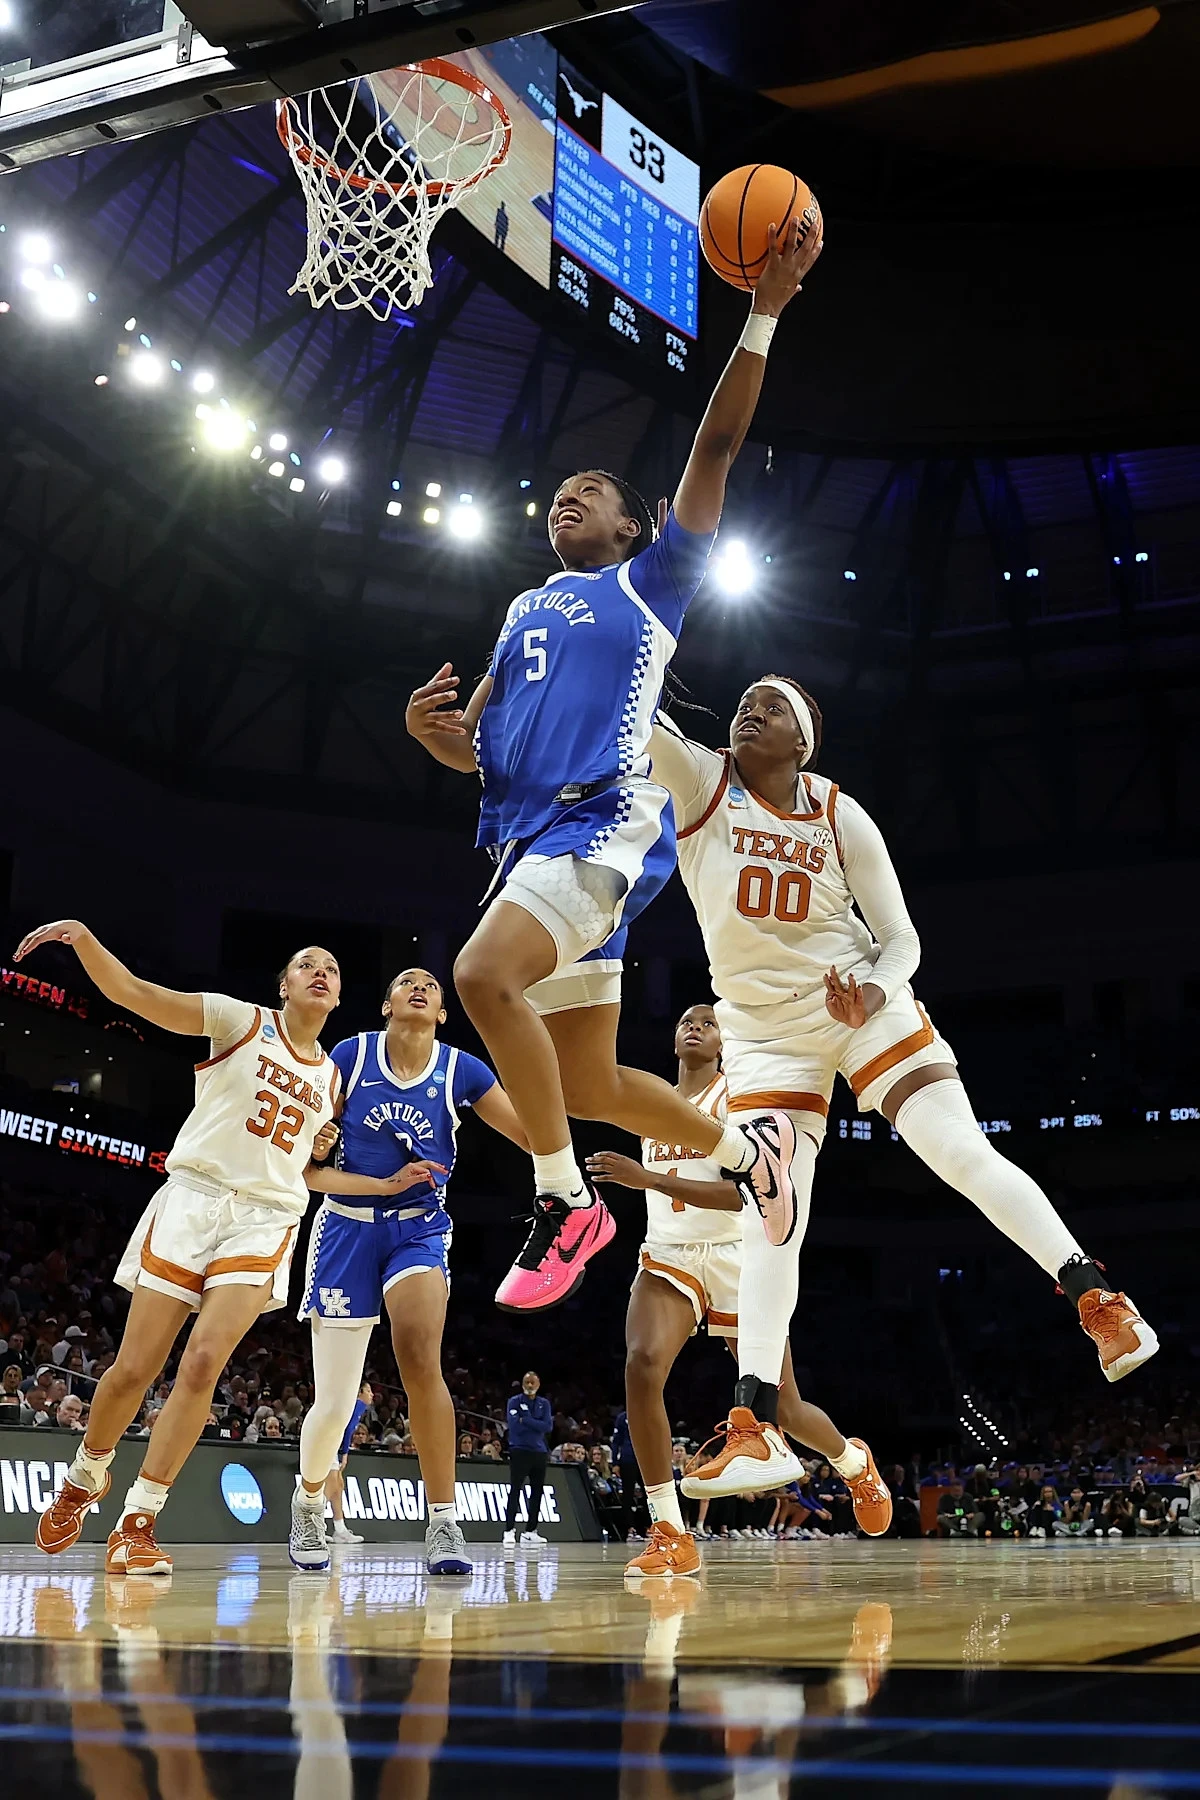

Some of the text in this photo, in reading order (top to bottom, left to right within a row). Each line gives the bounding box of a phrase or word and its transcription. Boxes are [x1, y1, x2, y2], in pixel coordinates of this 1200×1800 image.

[556, 127, 590, 166] PLAYER
[620, 180, 638, 203] PTS
[629, 127, 665, 184] 33
[560, 255, 588, 288] 3PT%
[666, 332, 687, 356] FT%
[498, 591, 596, 643] KENTUCKY
[523, 627, 548, 682] 5
[732, 826, 828, 874] TEXAS
[815, 829, 833, 847] SEC
[736, 864, 812, 923] 00
[256, 1054, 323, 1113] TEXAS
[245, 1090, 305, 1155] 32
[363, 1102, 434, 1141] KENTUCKY
[978, 1120, 1012, 1133] 1.3%
[1073, 1114, 1102, 1127] 25%
[1146, 1110, 1160, 1122] FT
[1170, 1108, 1200, 1121] 50%
[59, 1125, 146, 1167] SIXTEEN
[319, 1287, 351, 1316] UK
[227, 1492, 263, 1510] NCAA
